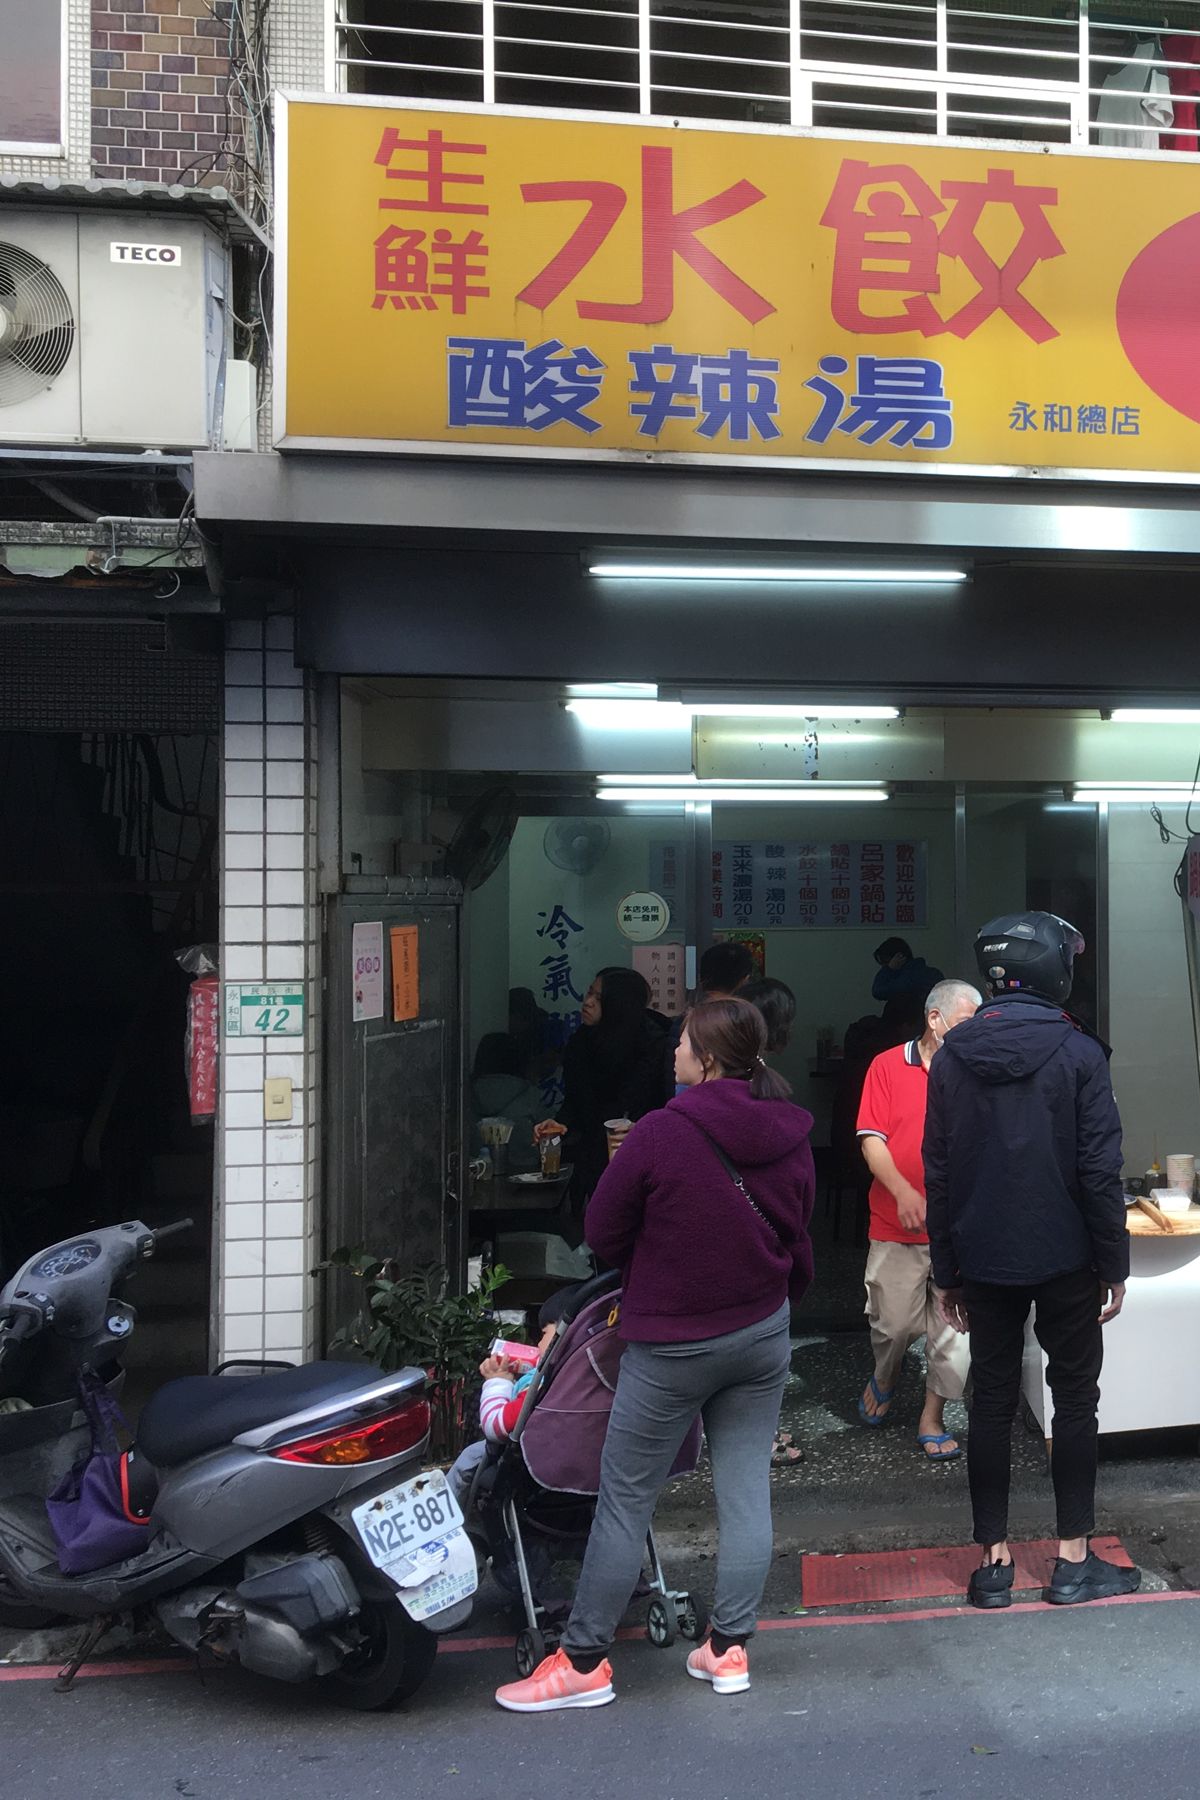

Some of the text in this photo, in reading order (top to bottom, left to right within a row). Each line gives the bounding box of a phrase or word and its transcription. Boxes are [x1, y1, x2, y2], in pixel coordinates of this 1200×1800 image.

[371, 127, 490, 315] 生鮮
[519, 145, 1067, 344] 水餃
[115, 245, 177, 263] TECO
[446, 335, 955, 451] 酸辣湯
[1008, 400, 1142, 437] 永和總店
[624, 905, 660, 913] 本店免用
[860, 843, 885, 924] 呂家鍋貼
[895, 843, 916, 923] 歡迎光臨
[227, 988, 239, 1031] 永和區
[255, 1008, 290, 1031] 42
